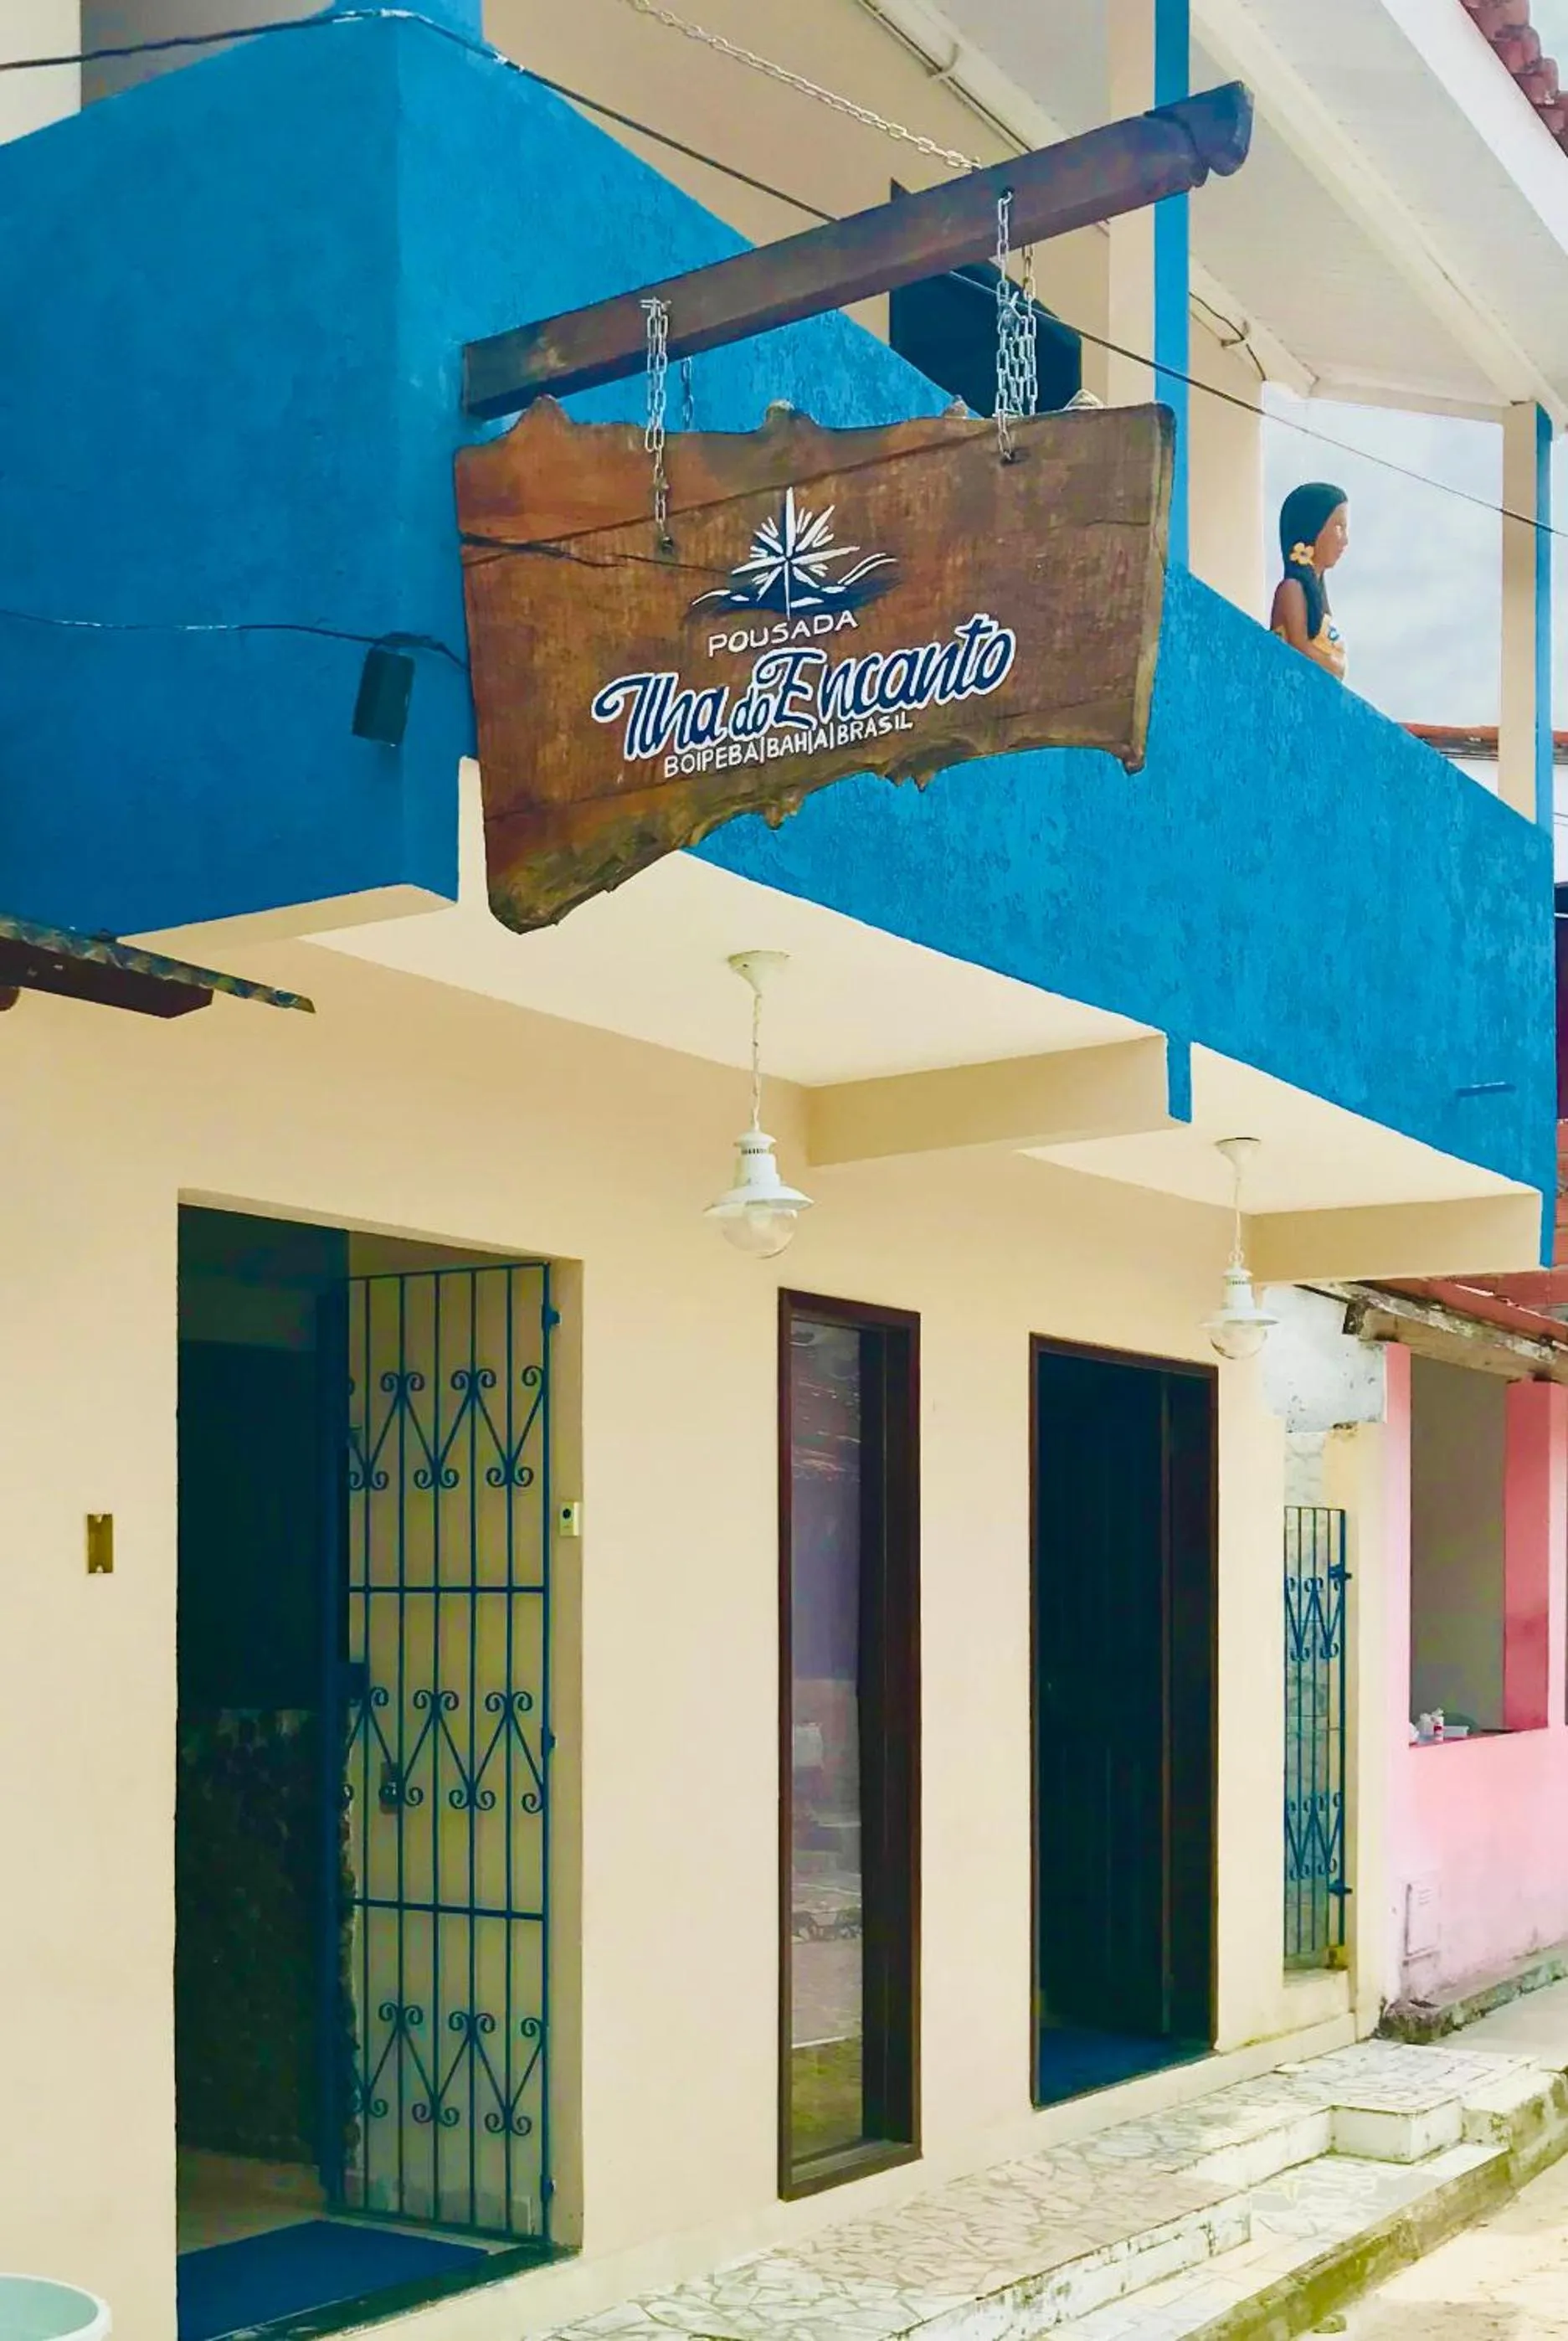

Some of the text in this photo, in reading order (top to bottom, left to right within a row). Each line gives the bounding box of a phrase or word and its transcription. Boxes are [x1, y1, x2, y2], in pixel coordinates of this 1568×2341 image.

[707, 610, 859, 658] POUSADA
[591, 613, 1015, 762] Ilha do Encanto
